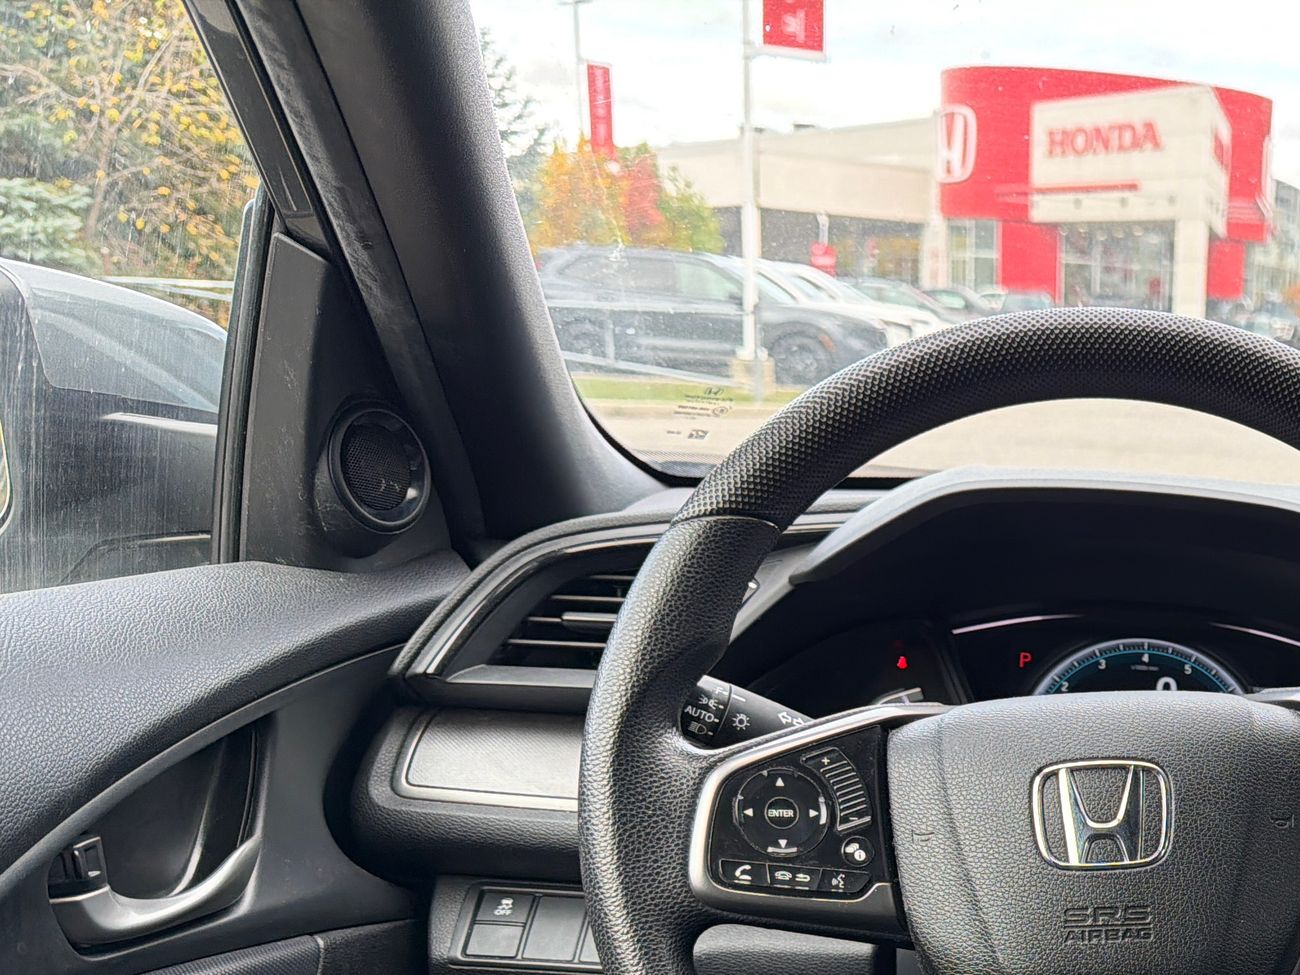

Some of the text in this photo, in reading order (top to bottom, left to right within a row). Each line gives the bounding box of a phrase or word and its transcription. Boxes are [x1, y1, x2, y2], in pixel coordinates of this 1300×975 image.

[1047, 122, 1163, 157] HONDA
[1019, 652, 1032, 668] P
[1098, 659, 1106, 669] 3
[1141, 653, 1149, 663] 4
[1184, 663, 1192, 675] 5
[1061, 681, 1069, 692] 2
[684, 705, 714, 722] AUTO
[768, 808, 794, 818] ENTER
[1064, 906, 1152, 924] SRS
[1064, 927, 1153, 943] AIRBAG
